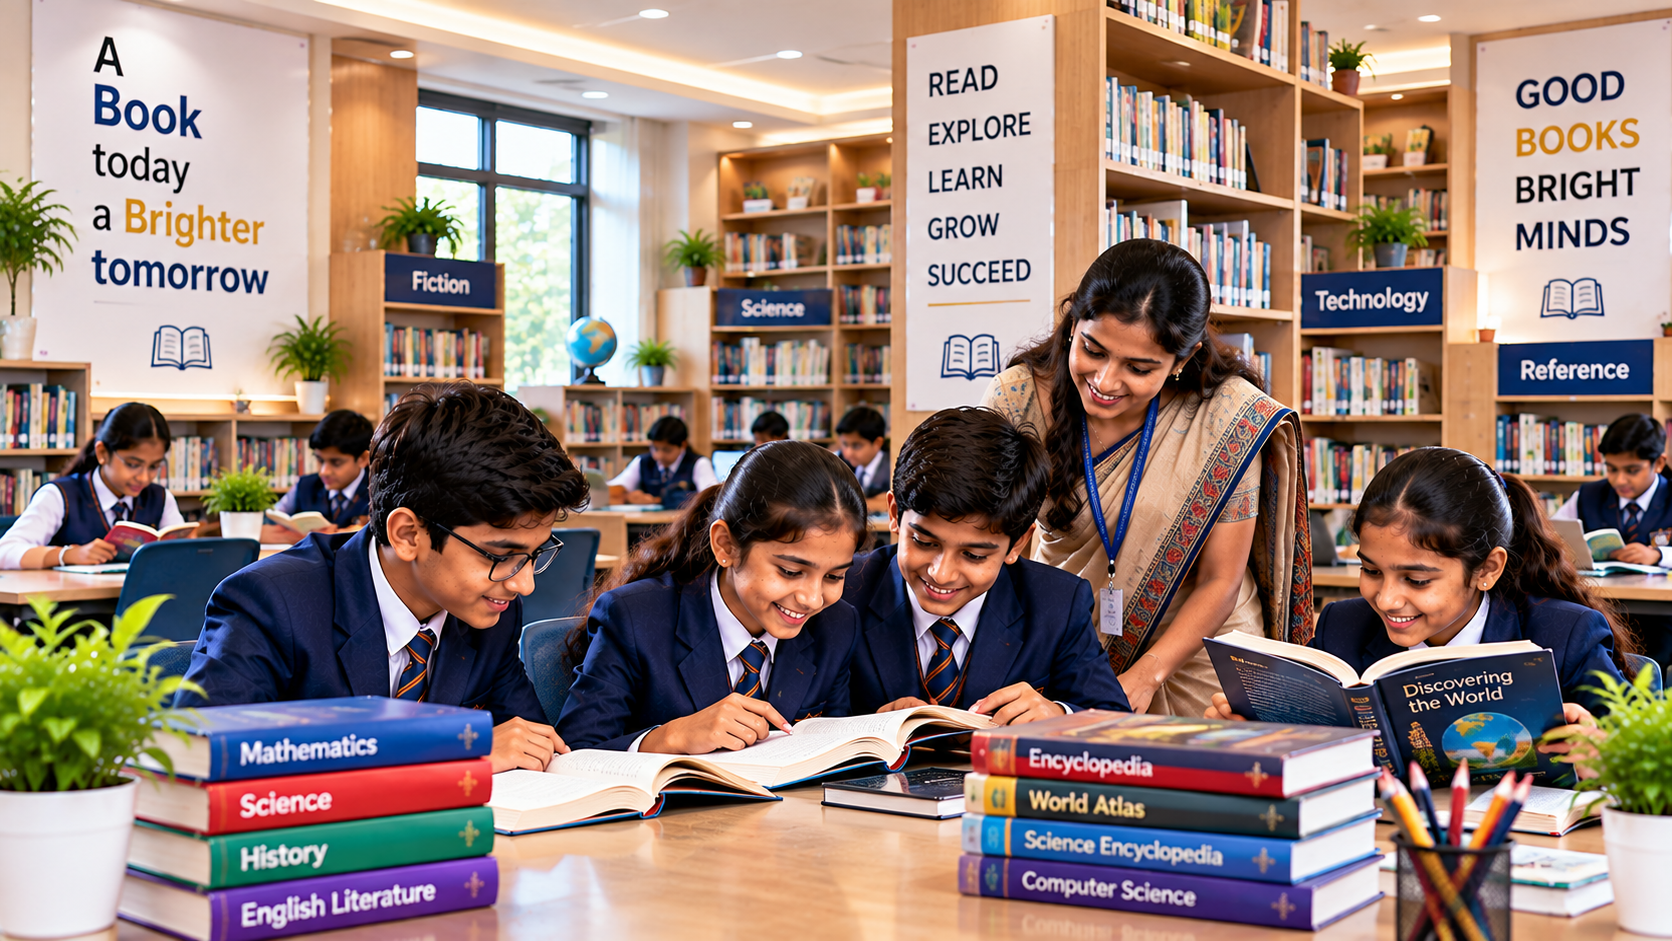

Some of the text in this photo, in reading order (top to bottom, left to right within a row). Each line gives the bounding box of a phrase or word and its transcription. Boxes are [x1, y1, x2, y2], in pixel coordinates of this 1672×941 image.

[94, 37, 123, 76] A
[930, 65, 998, 97] READ
[1516, 71, 1624, 109] GOOD
[95, 84, 202, 139] Book
[929, 112, 1030, 145] EXPLORE
[1517, 118, 1639, 157] BOOKS
[93, 144, 189, 193] today
[929, 165, 1002, 193] LEARN
[1517, 168, 1640, 203] BRIGHT
[93, 199, 264, 247] a Brighter
[928, 213, 999, 240] GROW
[1517, 217, 1629, 250] MINDS
[92, 250, 268, 294] tomorrow
[412, 270, 470, 294] Fiction
[928, 259, 1031, 286] SUCCEED
[741, 299, 805, 317] Science
[1315, 287, 1428, 312] Technology
[1521, 358, 1629, 380] Reference
[1403, 671, 1513, 698] Discovering
[1409, 686, 1504, 713] the World
[240, 734, 378, 766] Mathematics
[1028, 747, 1153, 778] Encyclopedia
[241, 791, 332, 818] Science
[1029, 790, 1144, 817] World Atlas
[241, 844, 328, 871] History
[1025, 830, 1223, 866] Science Encyclopedia
[1022, 871, 1196, 906] Computer Science
[241, 884, 436, 929] English Literature
